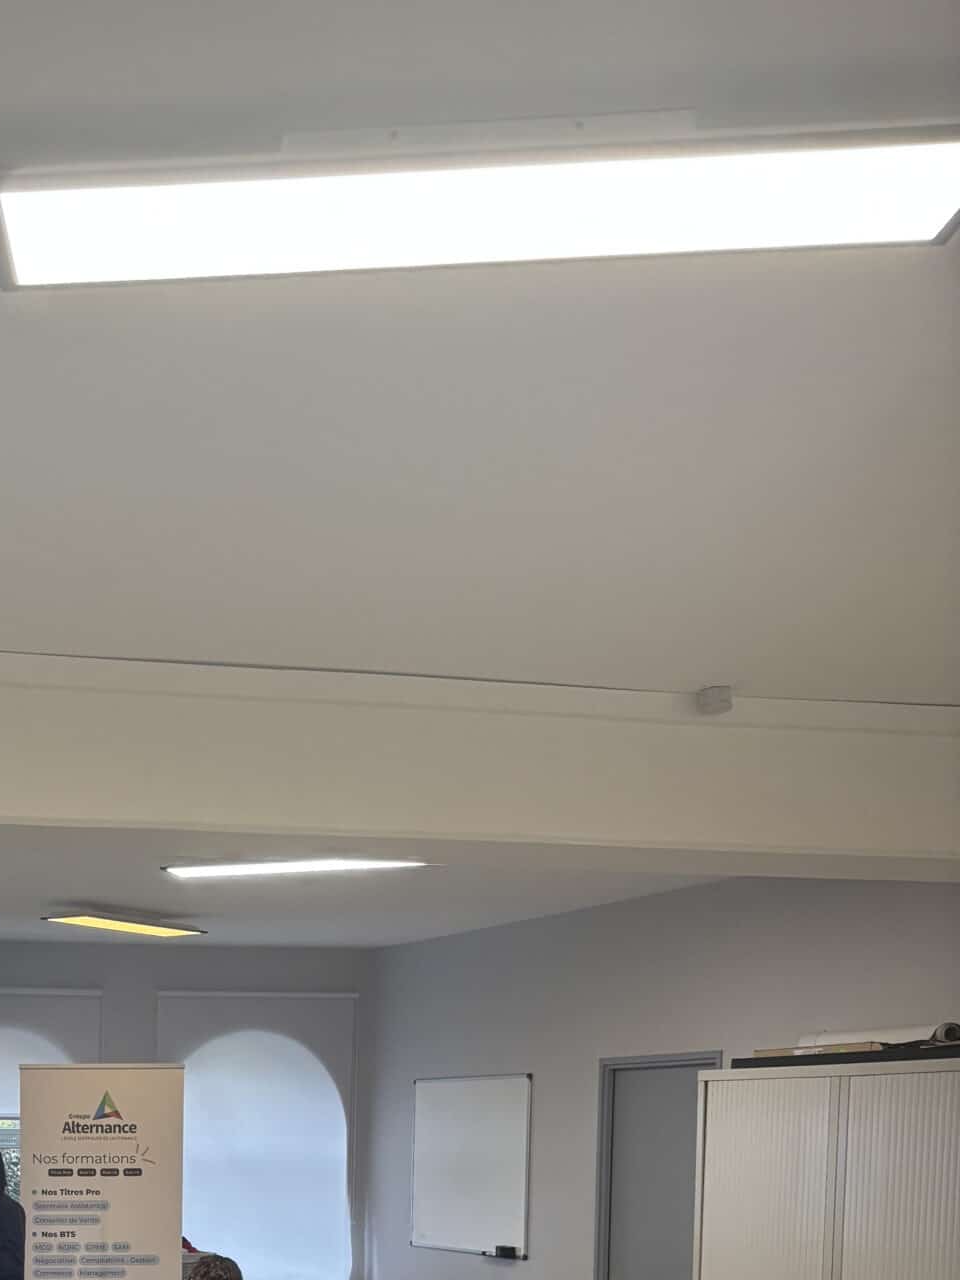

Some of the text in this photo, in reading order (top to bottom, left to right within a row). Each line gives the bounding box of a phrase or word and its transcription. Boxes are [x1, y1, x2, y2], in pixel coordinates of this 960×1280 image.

[62, 1120, 137, 1134] Alternance
[32, 1152, 137, 1165] Nos formations
[41, 1188, 101, 1196] Nos Titres Pro
